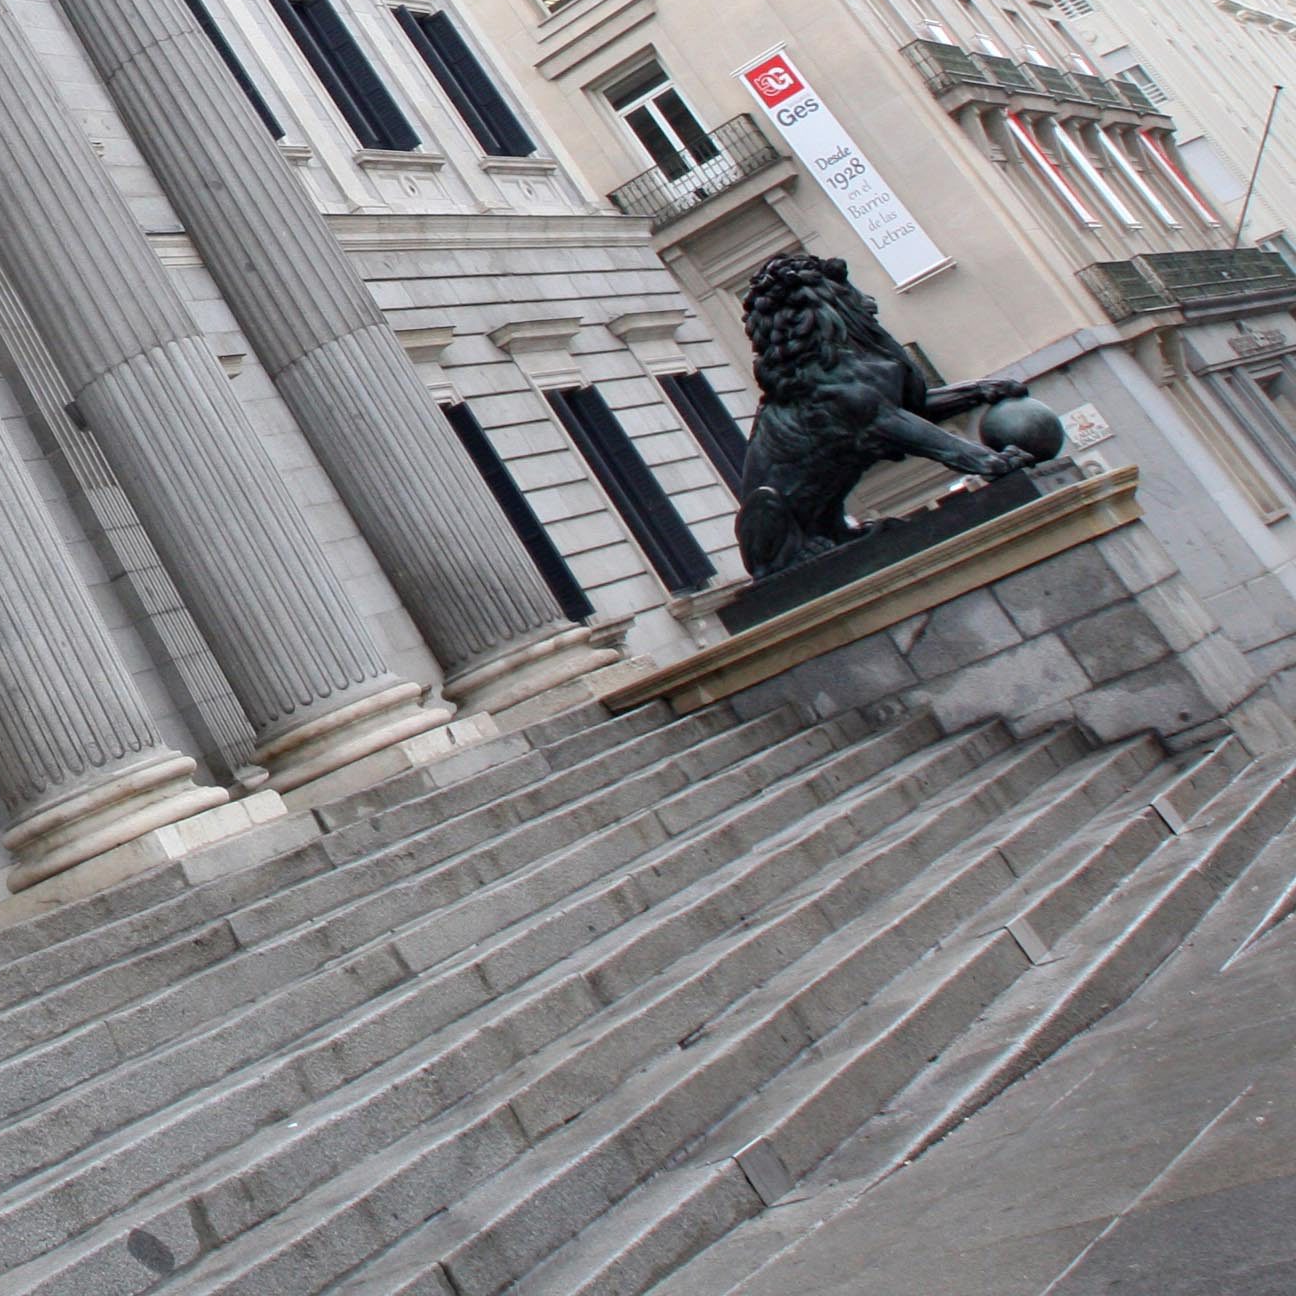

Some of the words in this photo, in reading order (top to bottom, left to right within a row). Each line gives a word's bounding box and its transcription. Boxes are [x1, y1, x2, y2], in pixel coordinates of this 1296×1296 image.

[777, 99, 819, 126] Ges
[815, 145, 852, 170] Desde
[826, 158, 866, 190] 1928
[848, 189, 862, 200] en
[861, 179, 872, 192] el
[848, 192, 890, 219] Barrio
[868, 218, 881, 231] de
[879, 210, 898, 224] las
[870, 222, 916, 250] Letras
